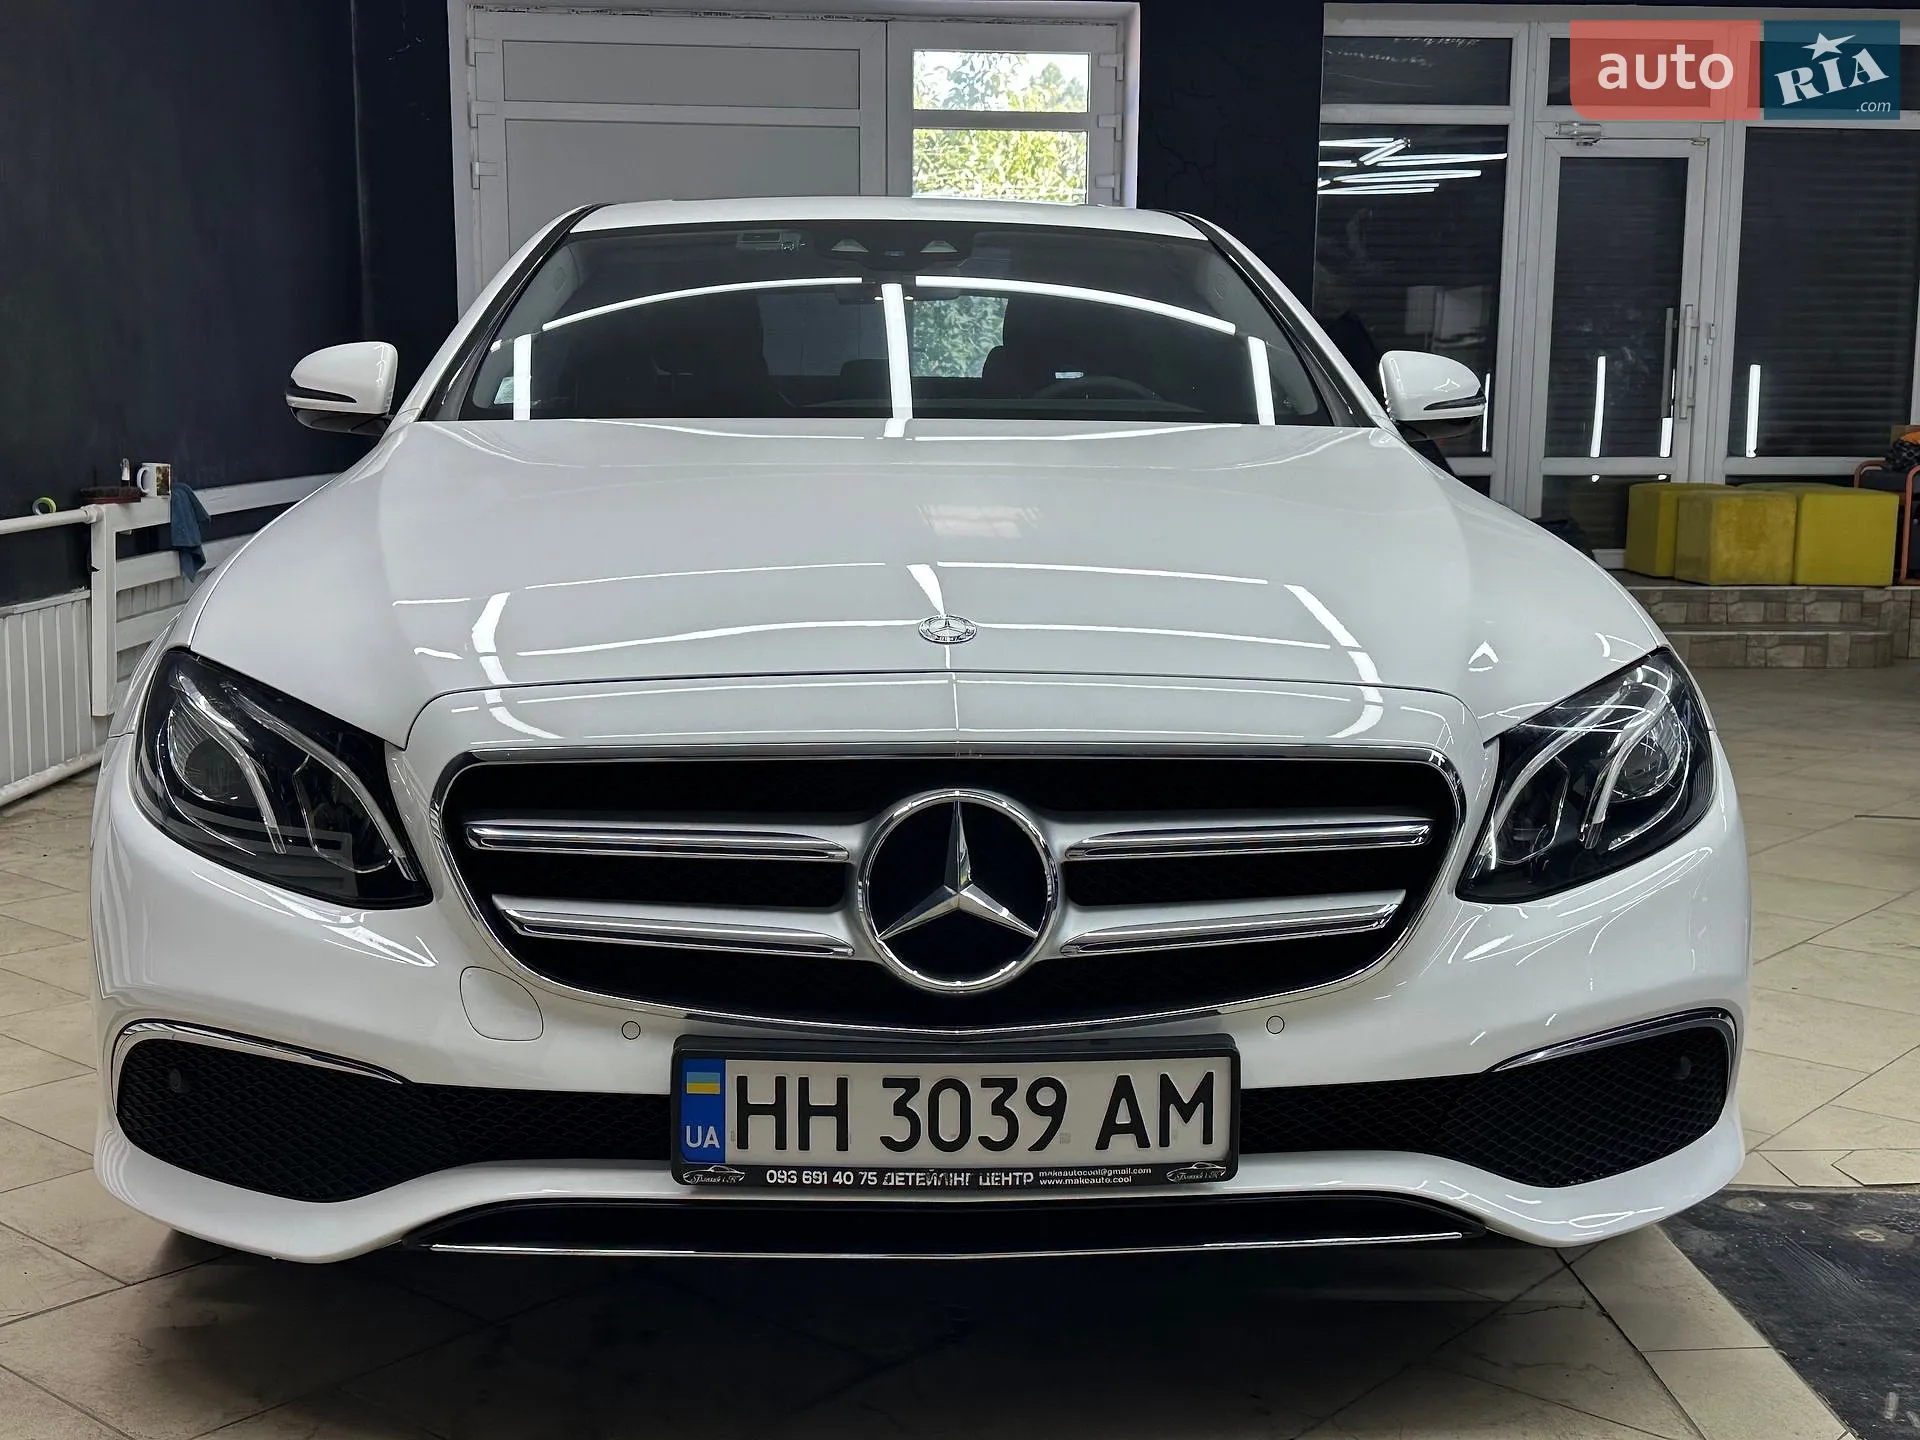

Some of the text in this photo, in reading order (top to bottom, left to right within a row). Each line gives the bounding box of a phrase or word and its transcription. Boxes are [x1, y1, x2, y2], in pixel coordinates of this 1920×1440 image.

[736, 1071, 1214, 1153] HH 3039 AM
[686, 1126, 720, 1149] UA
[766, 1169, 797, 1184] 093
[802, 1170, 828, 1184] 691
[832, 1171, 854, 1185] 40
[858, 1172, 878, 1185] 75
[979, 1171, 1034, 1186] ЦЕНТР
